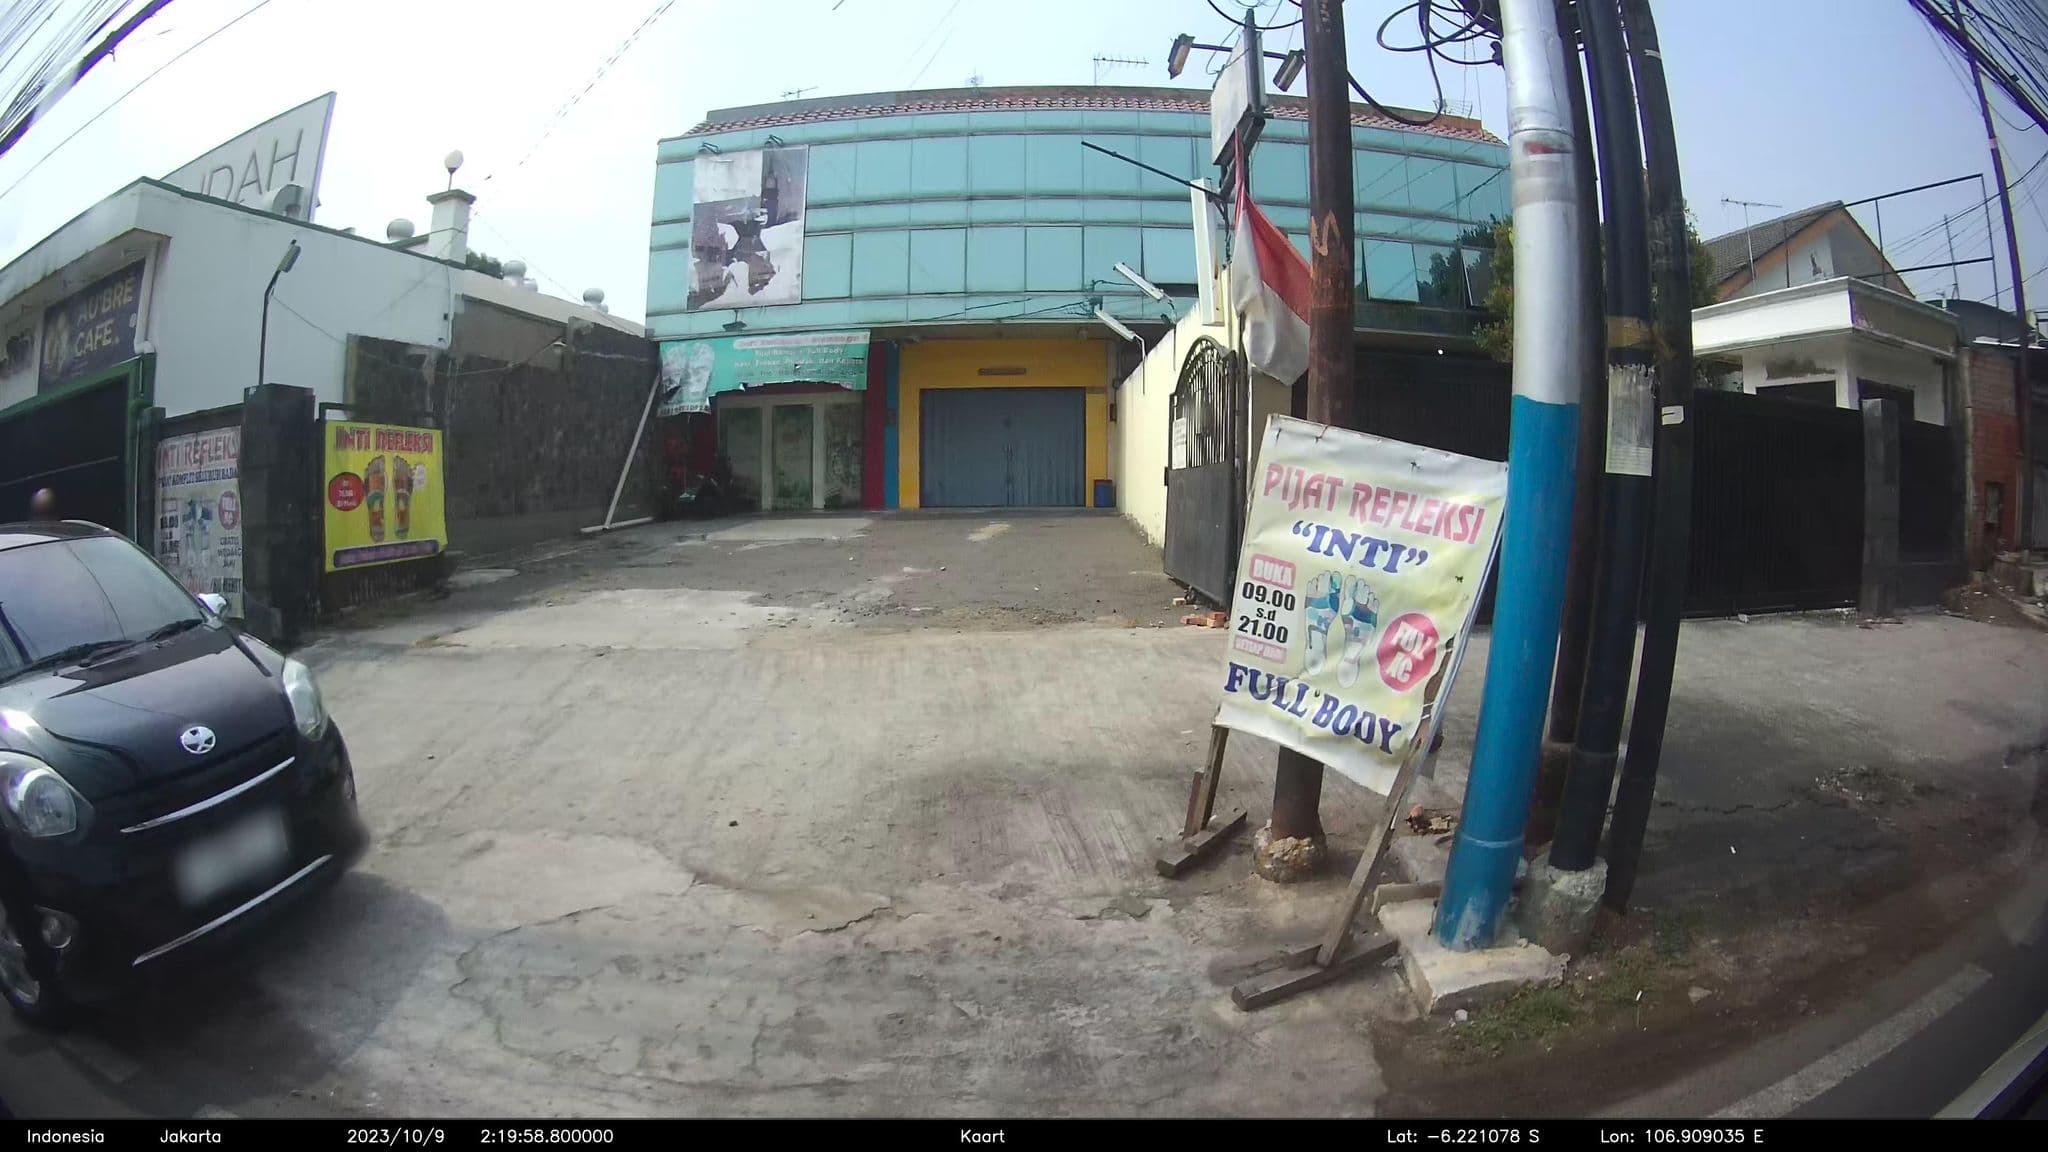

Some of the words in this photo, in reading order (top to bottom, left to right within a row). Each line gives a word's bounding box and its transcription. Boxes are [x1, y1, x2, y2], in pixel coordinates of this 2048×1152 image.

[336, 426, 371, 450] INTI
[1263, 463, 1344, 511] PIJAT
[1349, 481, 1485, 544] REFLEKSI
[1254, 559, 1292, 586] BUKA
[1242, 582, 1296, 611] 09.00
[1256, 608, 1277, 621] s.d
[1238, 615, 1289, 643] 21.00
[1224, 662, 1309, 717] FULL
[1312, 694, 1402, 755] BODY
